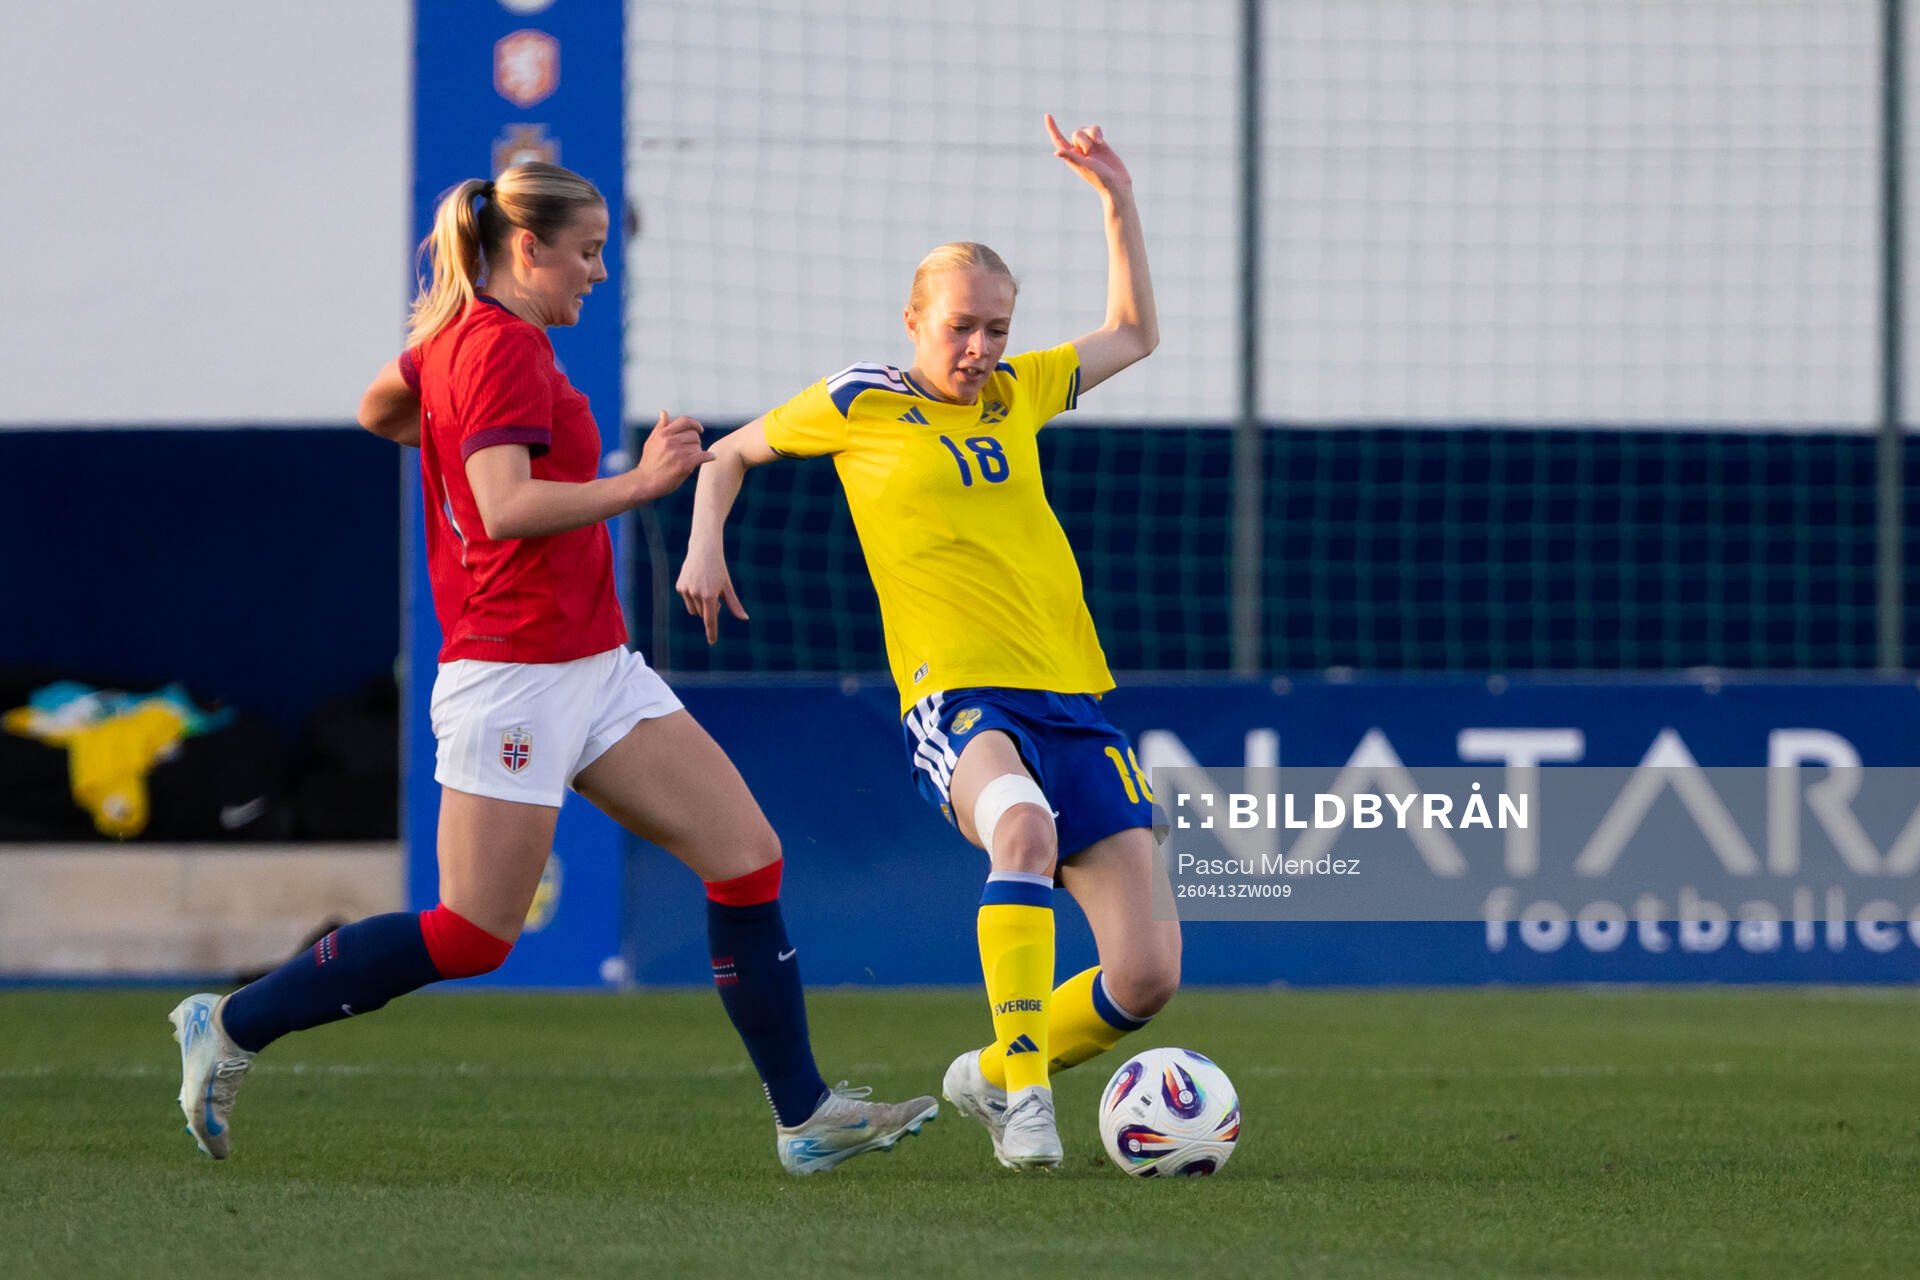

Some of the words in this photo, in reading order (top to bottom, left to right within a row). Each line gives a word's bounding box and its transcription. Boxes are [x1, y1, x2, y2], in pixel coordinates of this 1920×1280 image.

[940, 435, 1010, 487] 18
[1138, 729, 1920, 877] NATAR
[1483, 884, 1920, 953] footballc
